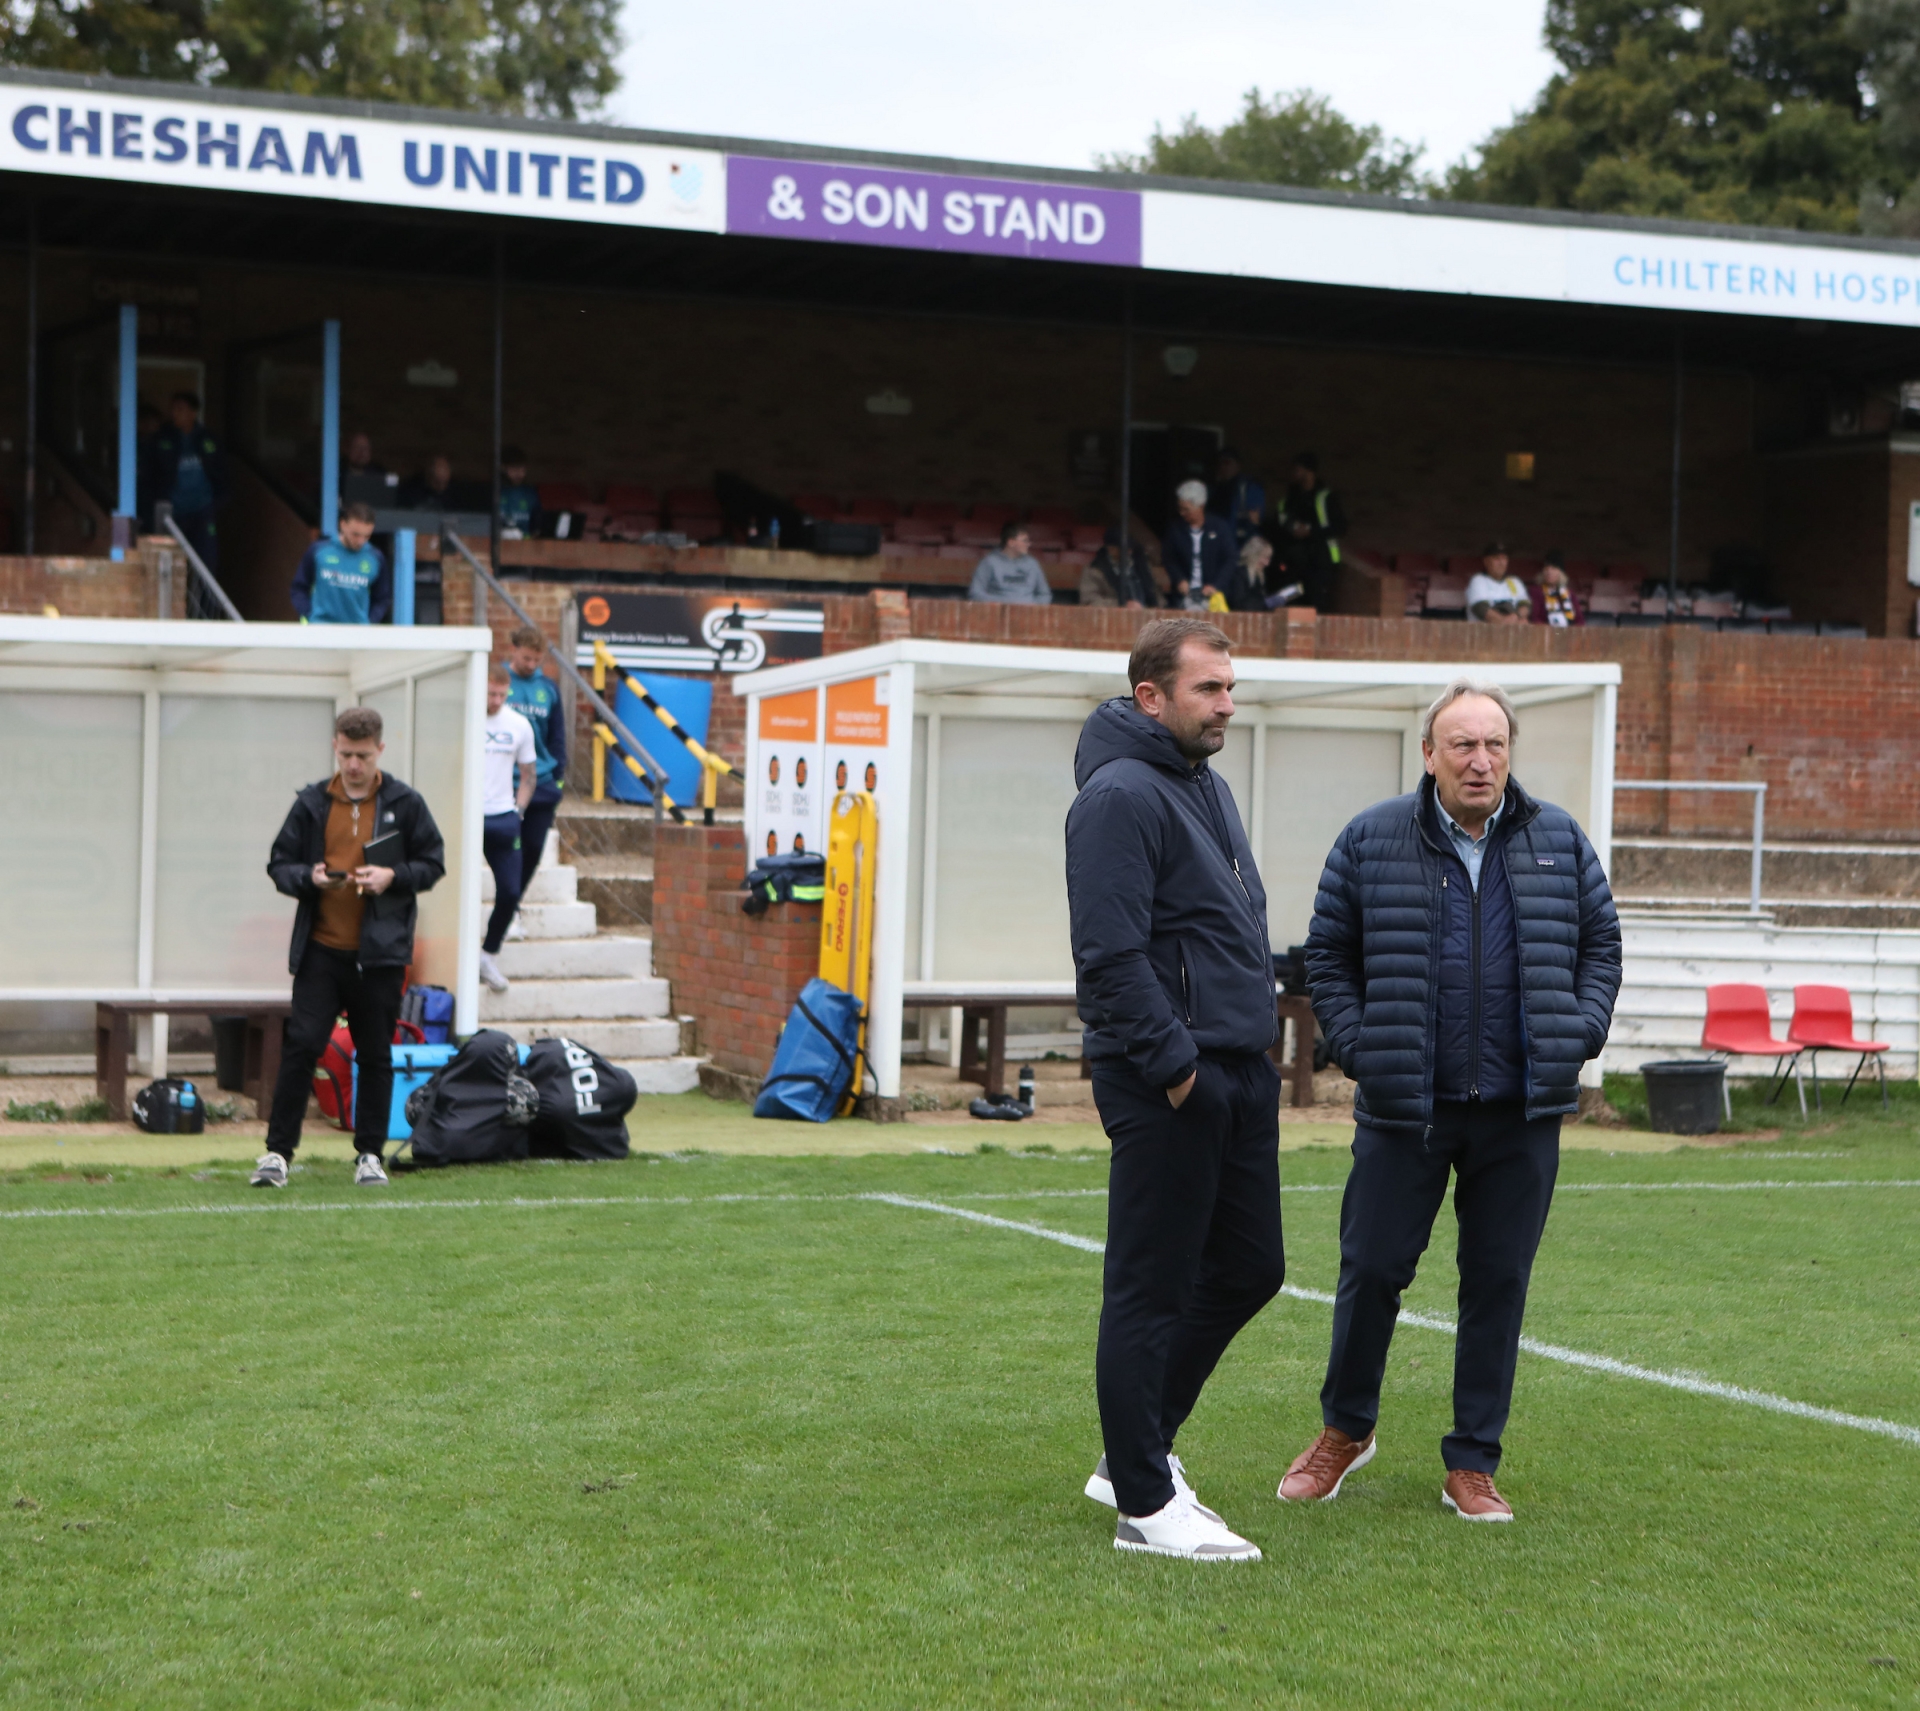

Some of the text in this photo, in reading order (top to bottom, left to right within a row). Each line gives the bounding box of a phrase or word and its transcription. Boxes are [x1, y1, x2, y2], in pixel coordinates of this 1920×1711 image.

[11, 104, 646, 206] CHESHAM UNITED
[767, 174, 1106, 246] & SON STAND
[1613, 254, 1797, 297] CHILTERN
